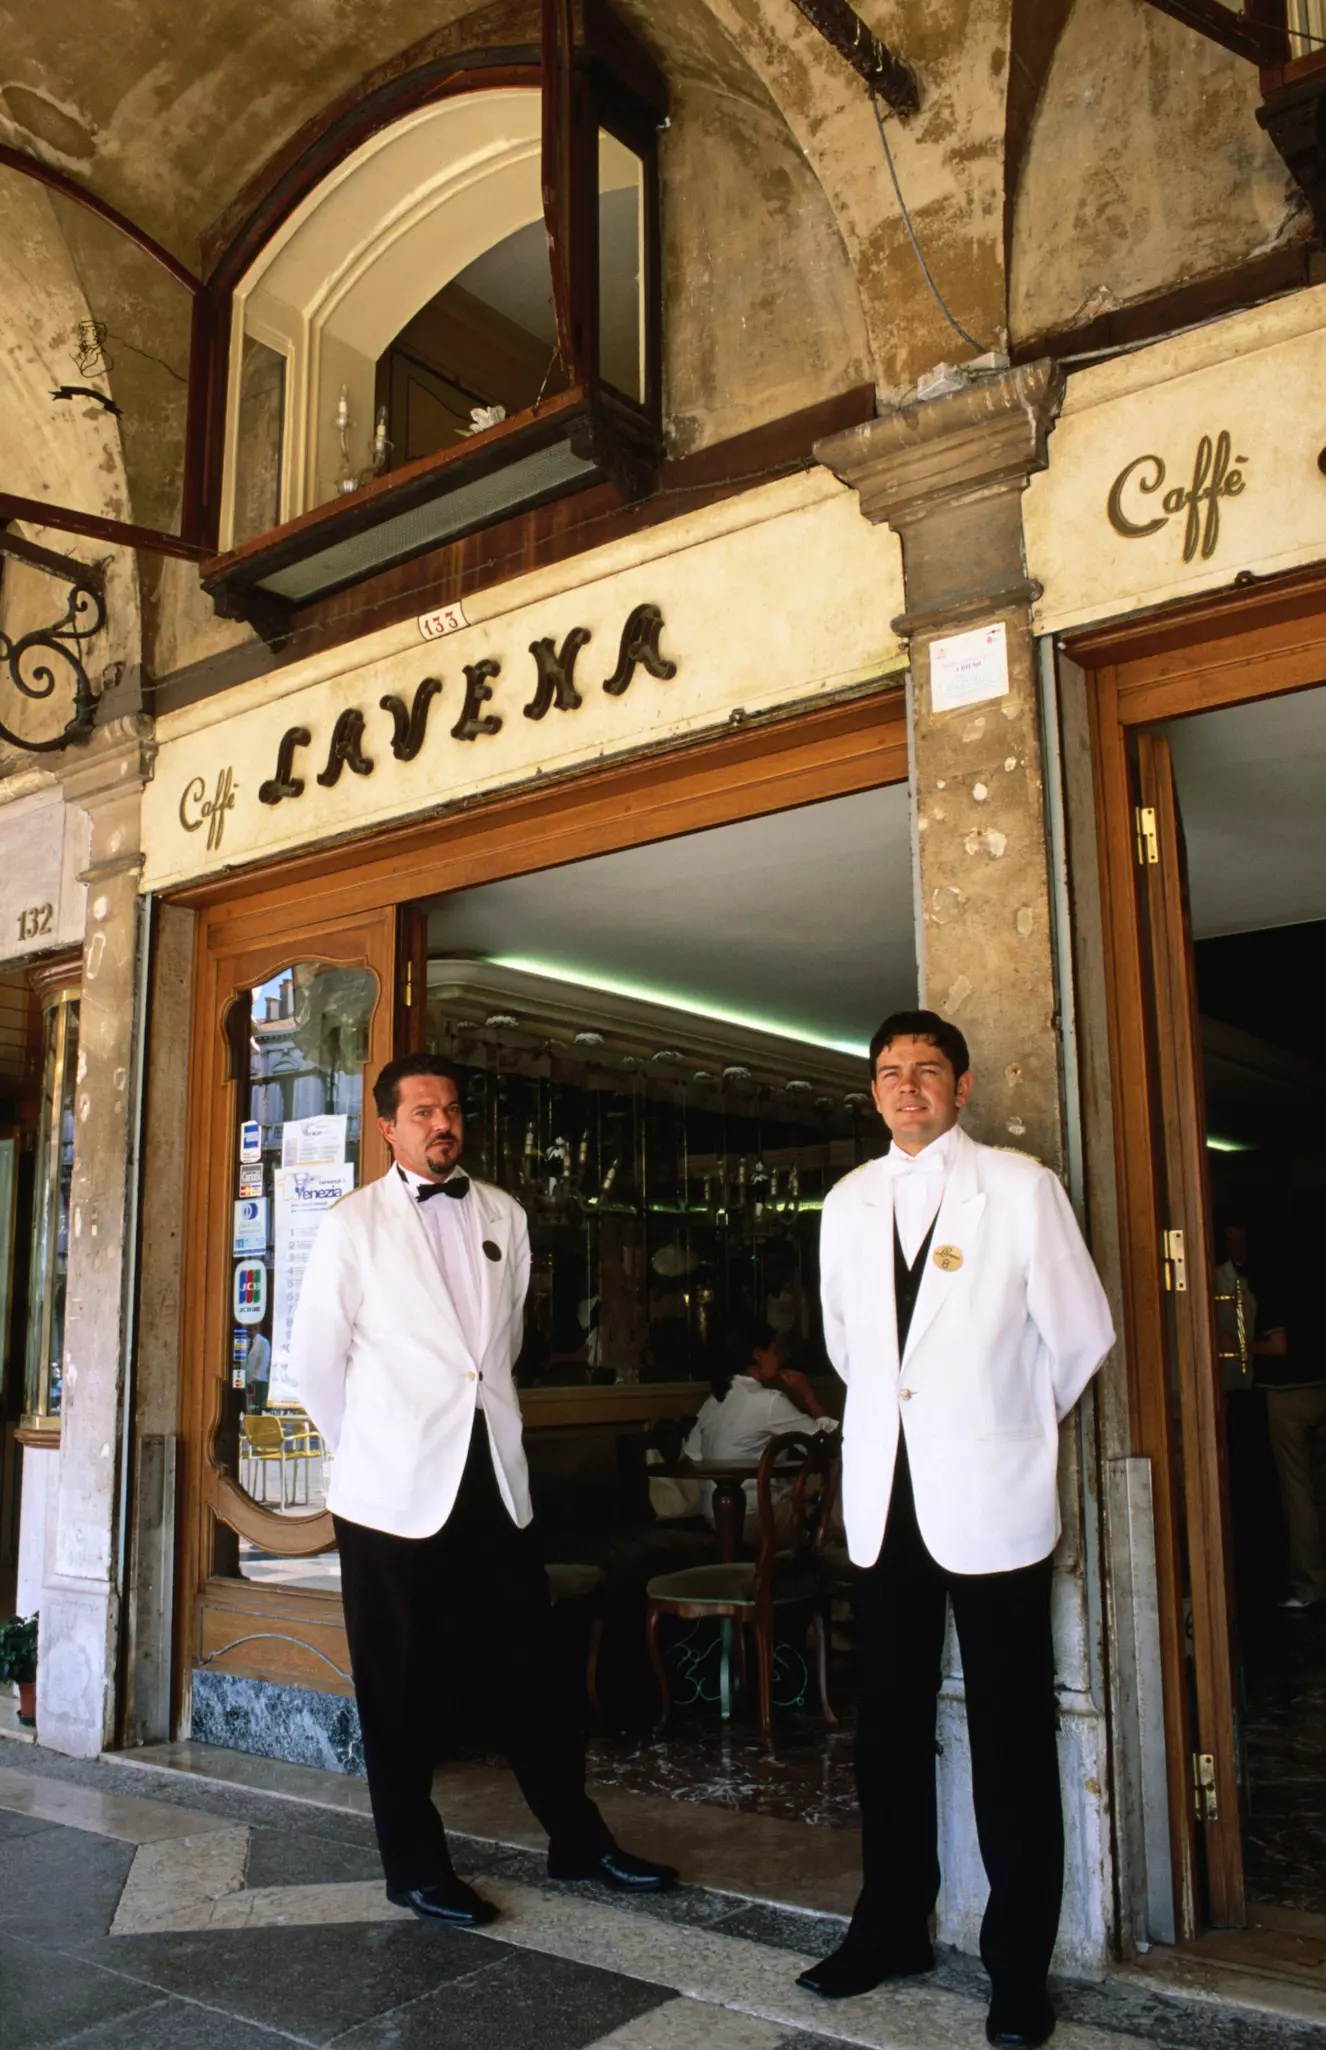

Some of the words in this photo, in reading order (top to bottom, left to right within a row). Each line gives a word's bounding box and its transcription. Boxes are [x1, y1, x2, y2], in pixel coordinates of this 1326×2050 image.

[1107, 430, 1250, 563] Caffè
[424, 610, 459, 636] 133
[258, 603, 677, 805] LAVENA
[17, 902, 53, 942] 132
[295, 1185, 342, 1200] Venezia
[239, 1282, 261, 1292] JCB
